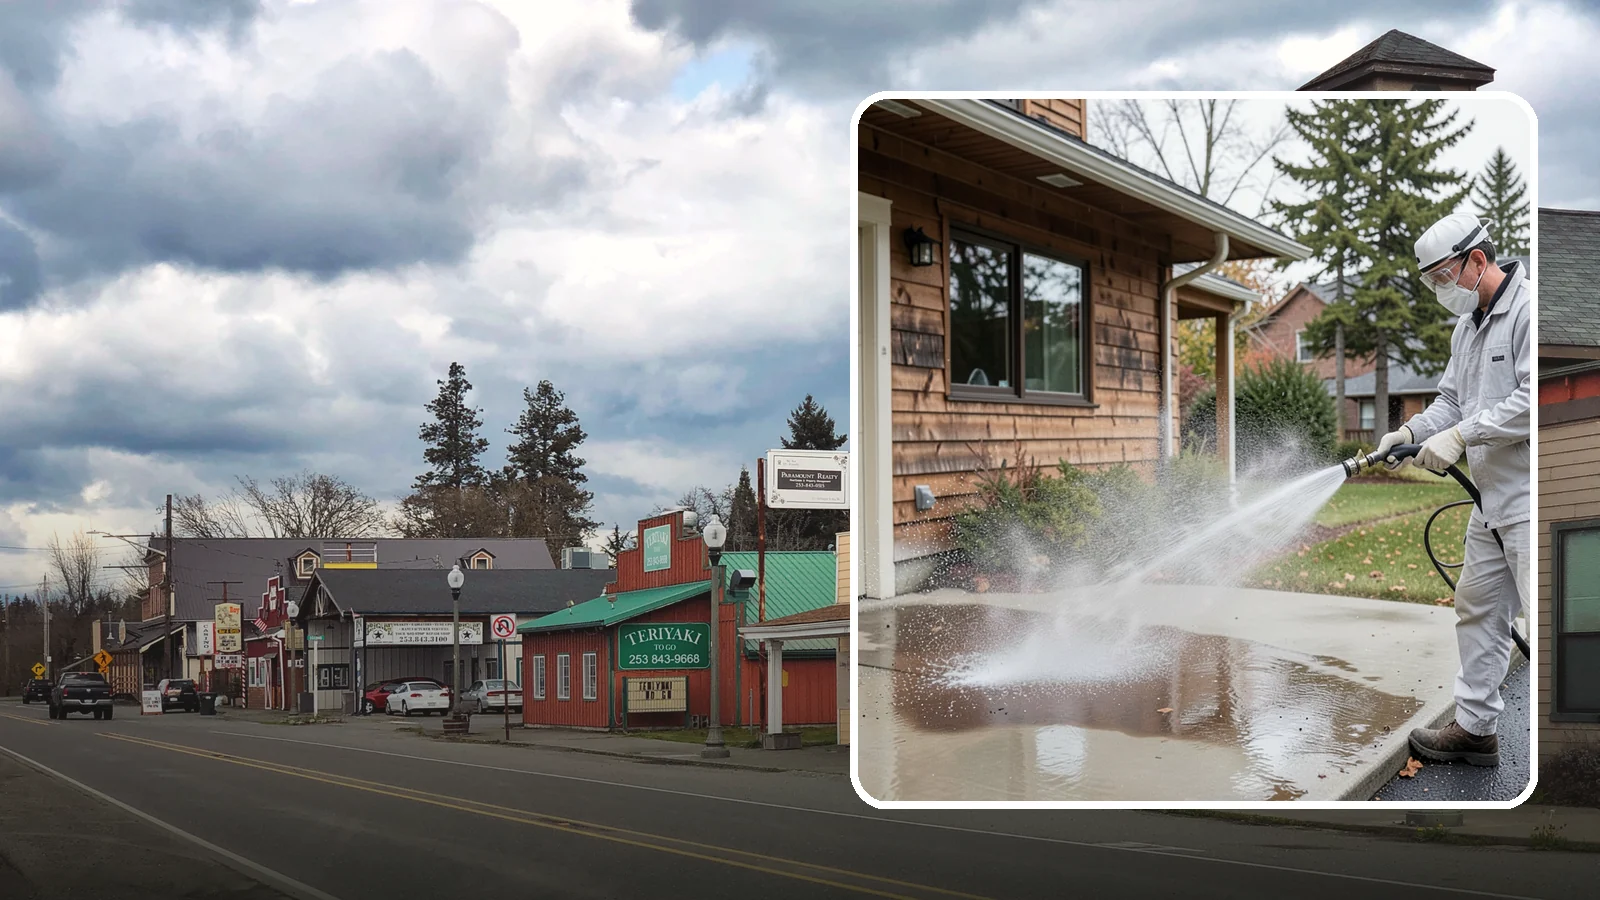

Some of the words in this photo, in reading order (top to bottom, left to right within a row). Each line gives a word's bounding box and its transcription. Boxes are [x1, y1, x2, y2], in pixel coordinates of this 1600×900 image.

[625, 628, 702, 645] TERIYAKI
[629, 654, 648, 664] 253
[651, 654, 699, 664] 843-9668
